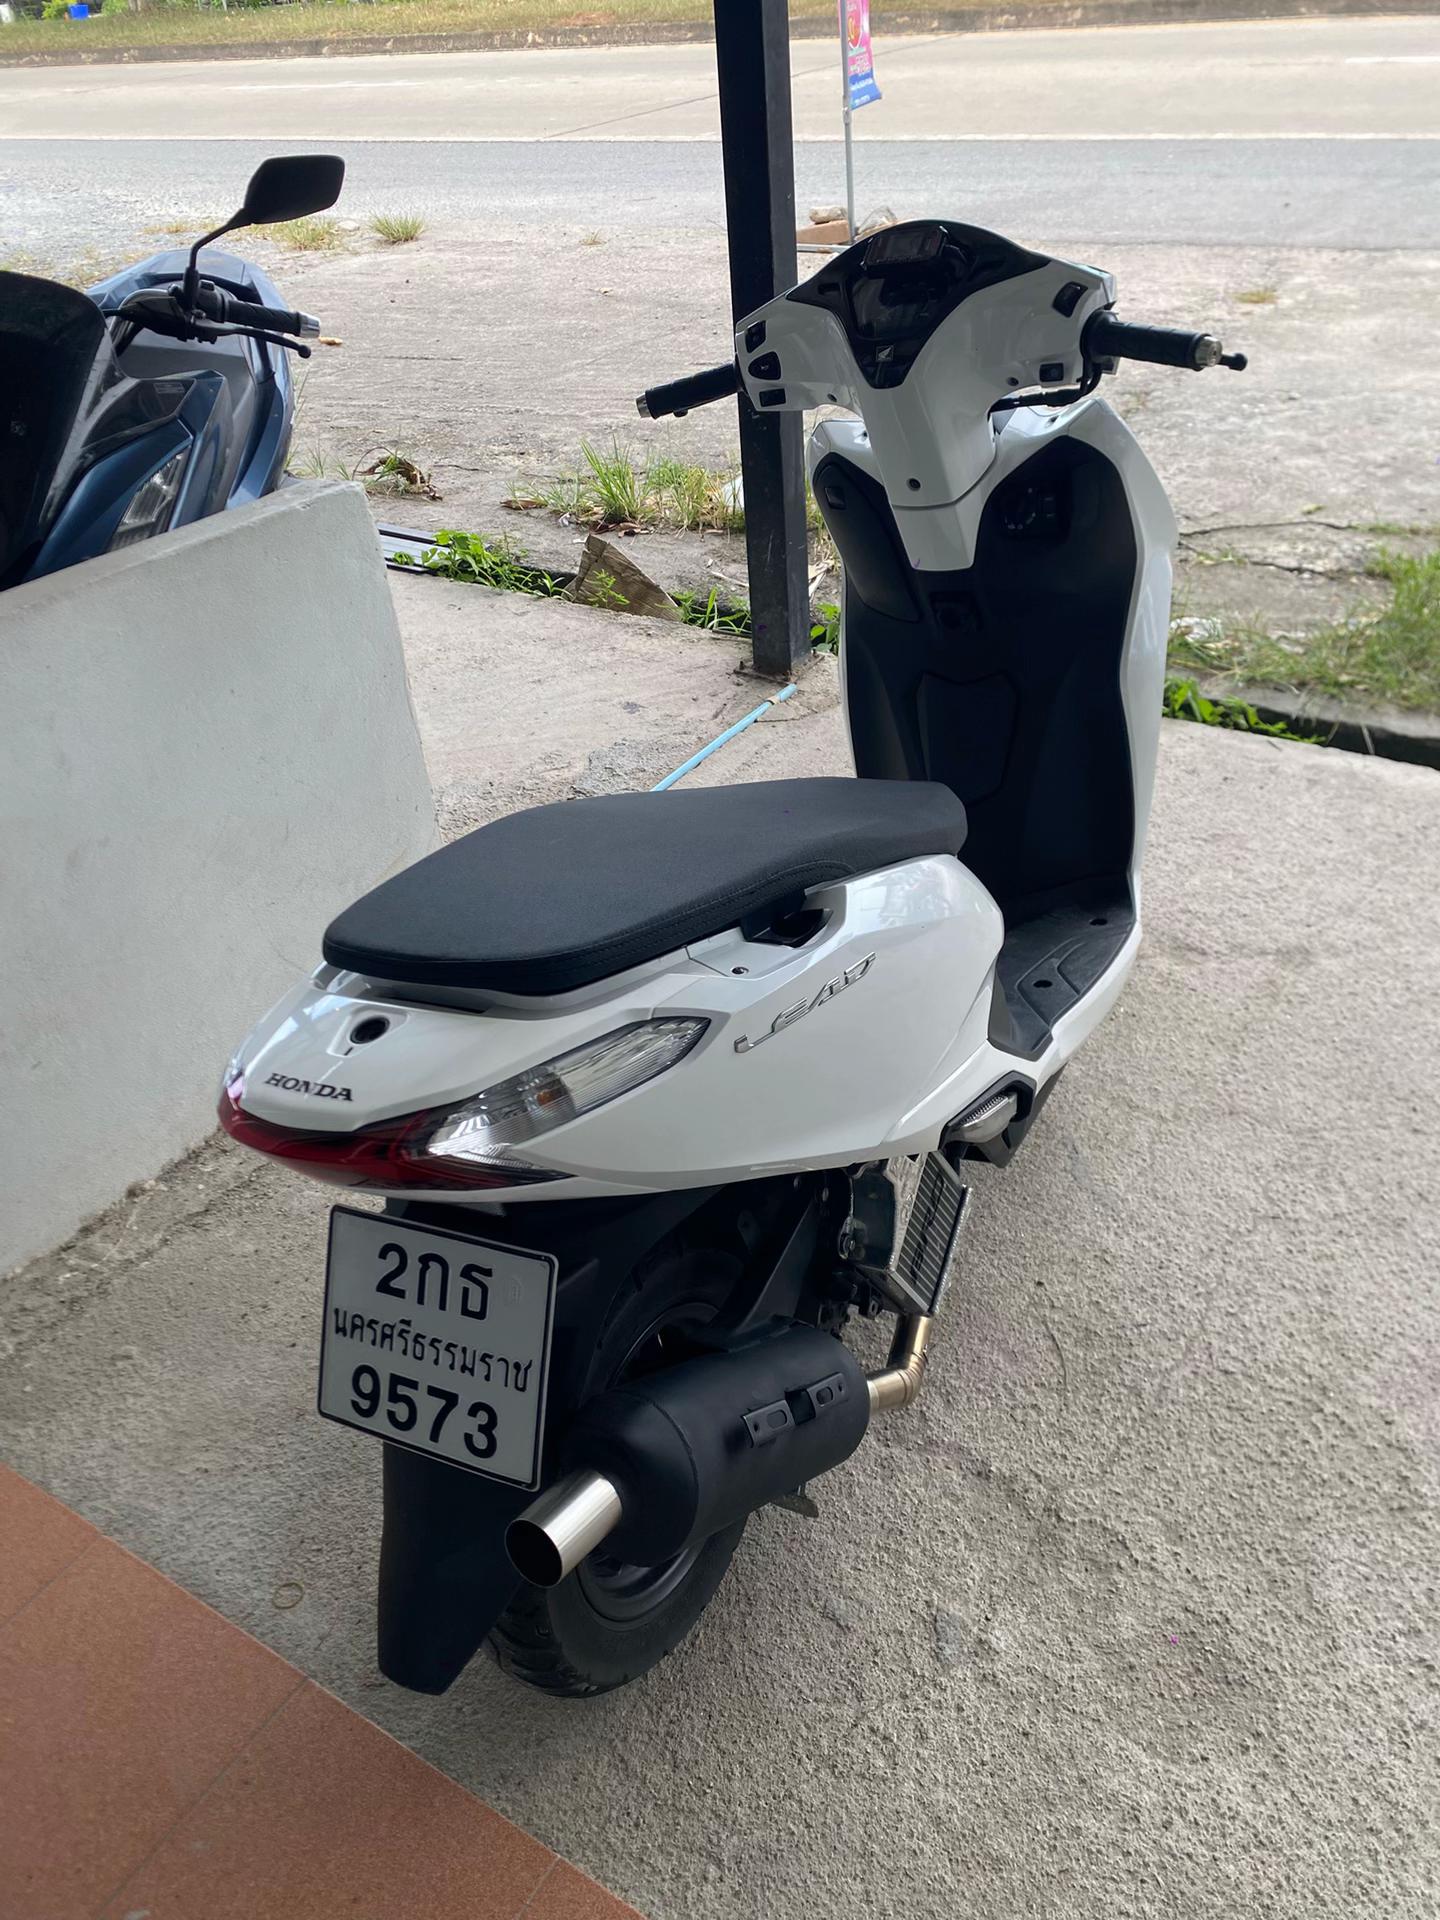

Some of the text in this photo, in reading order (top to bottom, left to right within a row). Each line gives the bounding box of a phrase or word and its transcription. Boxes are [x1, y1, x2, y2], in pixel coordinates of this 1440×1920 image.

[734, 951, 877, 1053] LEAD
[264, 1072, 353, 1101] HONDA
[375, 1242, 493, 1320] 2กธ
[333, 1307, 533, 1392] นครศรีธรรมราช
[350, 1364, 498, 1459] 9573
